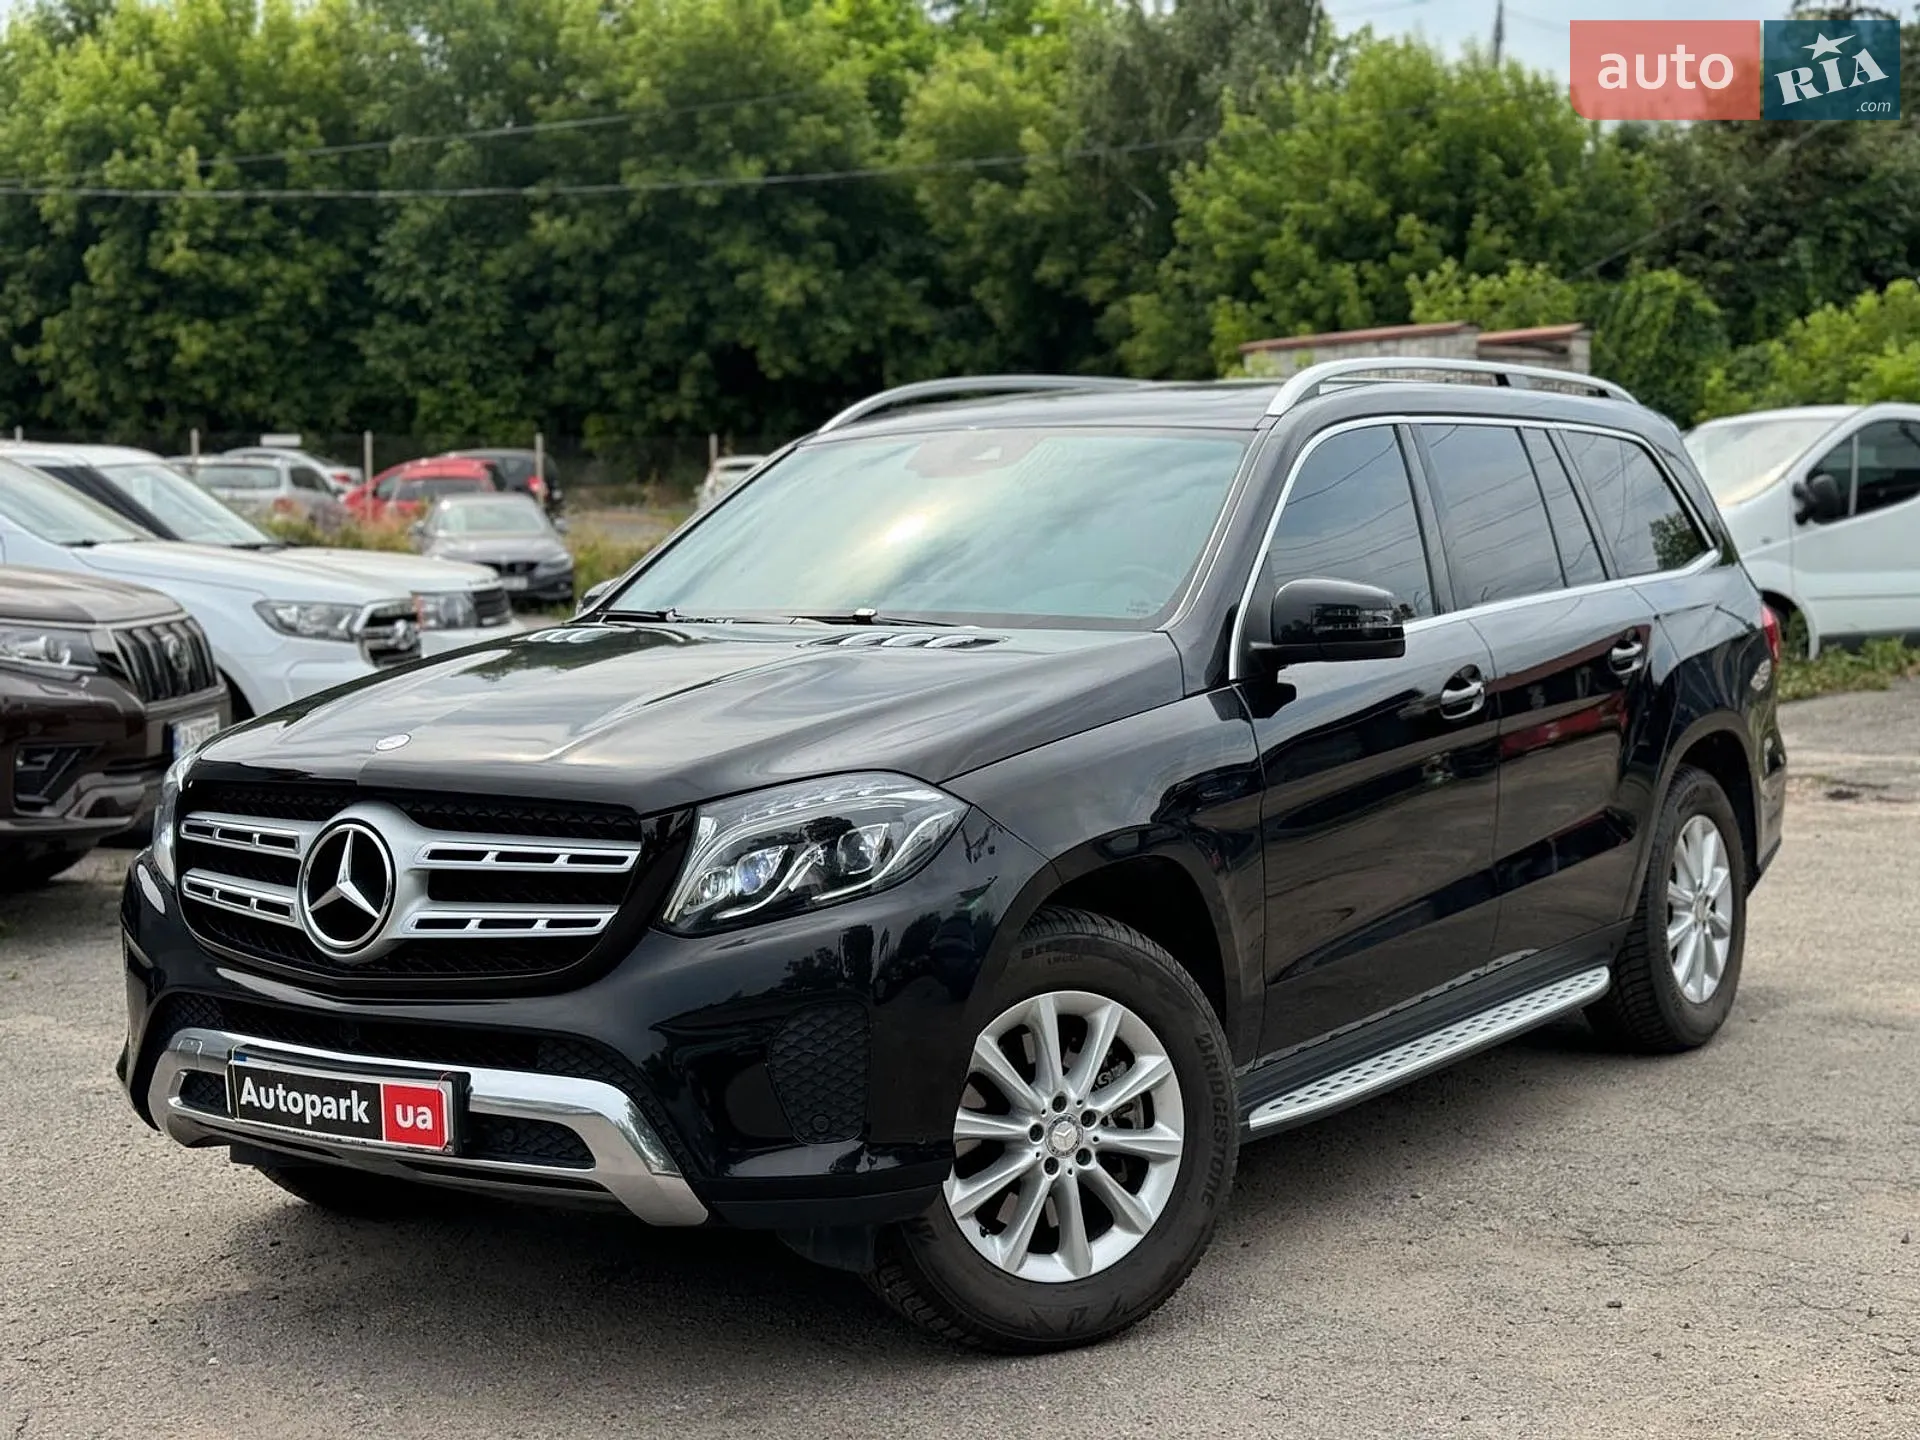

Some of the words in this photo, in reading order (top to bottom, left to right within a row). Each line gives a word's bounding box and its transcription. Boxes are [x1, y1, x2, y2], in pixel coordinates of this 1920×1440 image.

[240, 1076, 370, 1125] Autopark
[395, 1103, 434, 1131] ua
[1194, 1032, 1229, 1211] BRIDGESTONE
